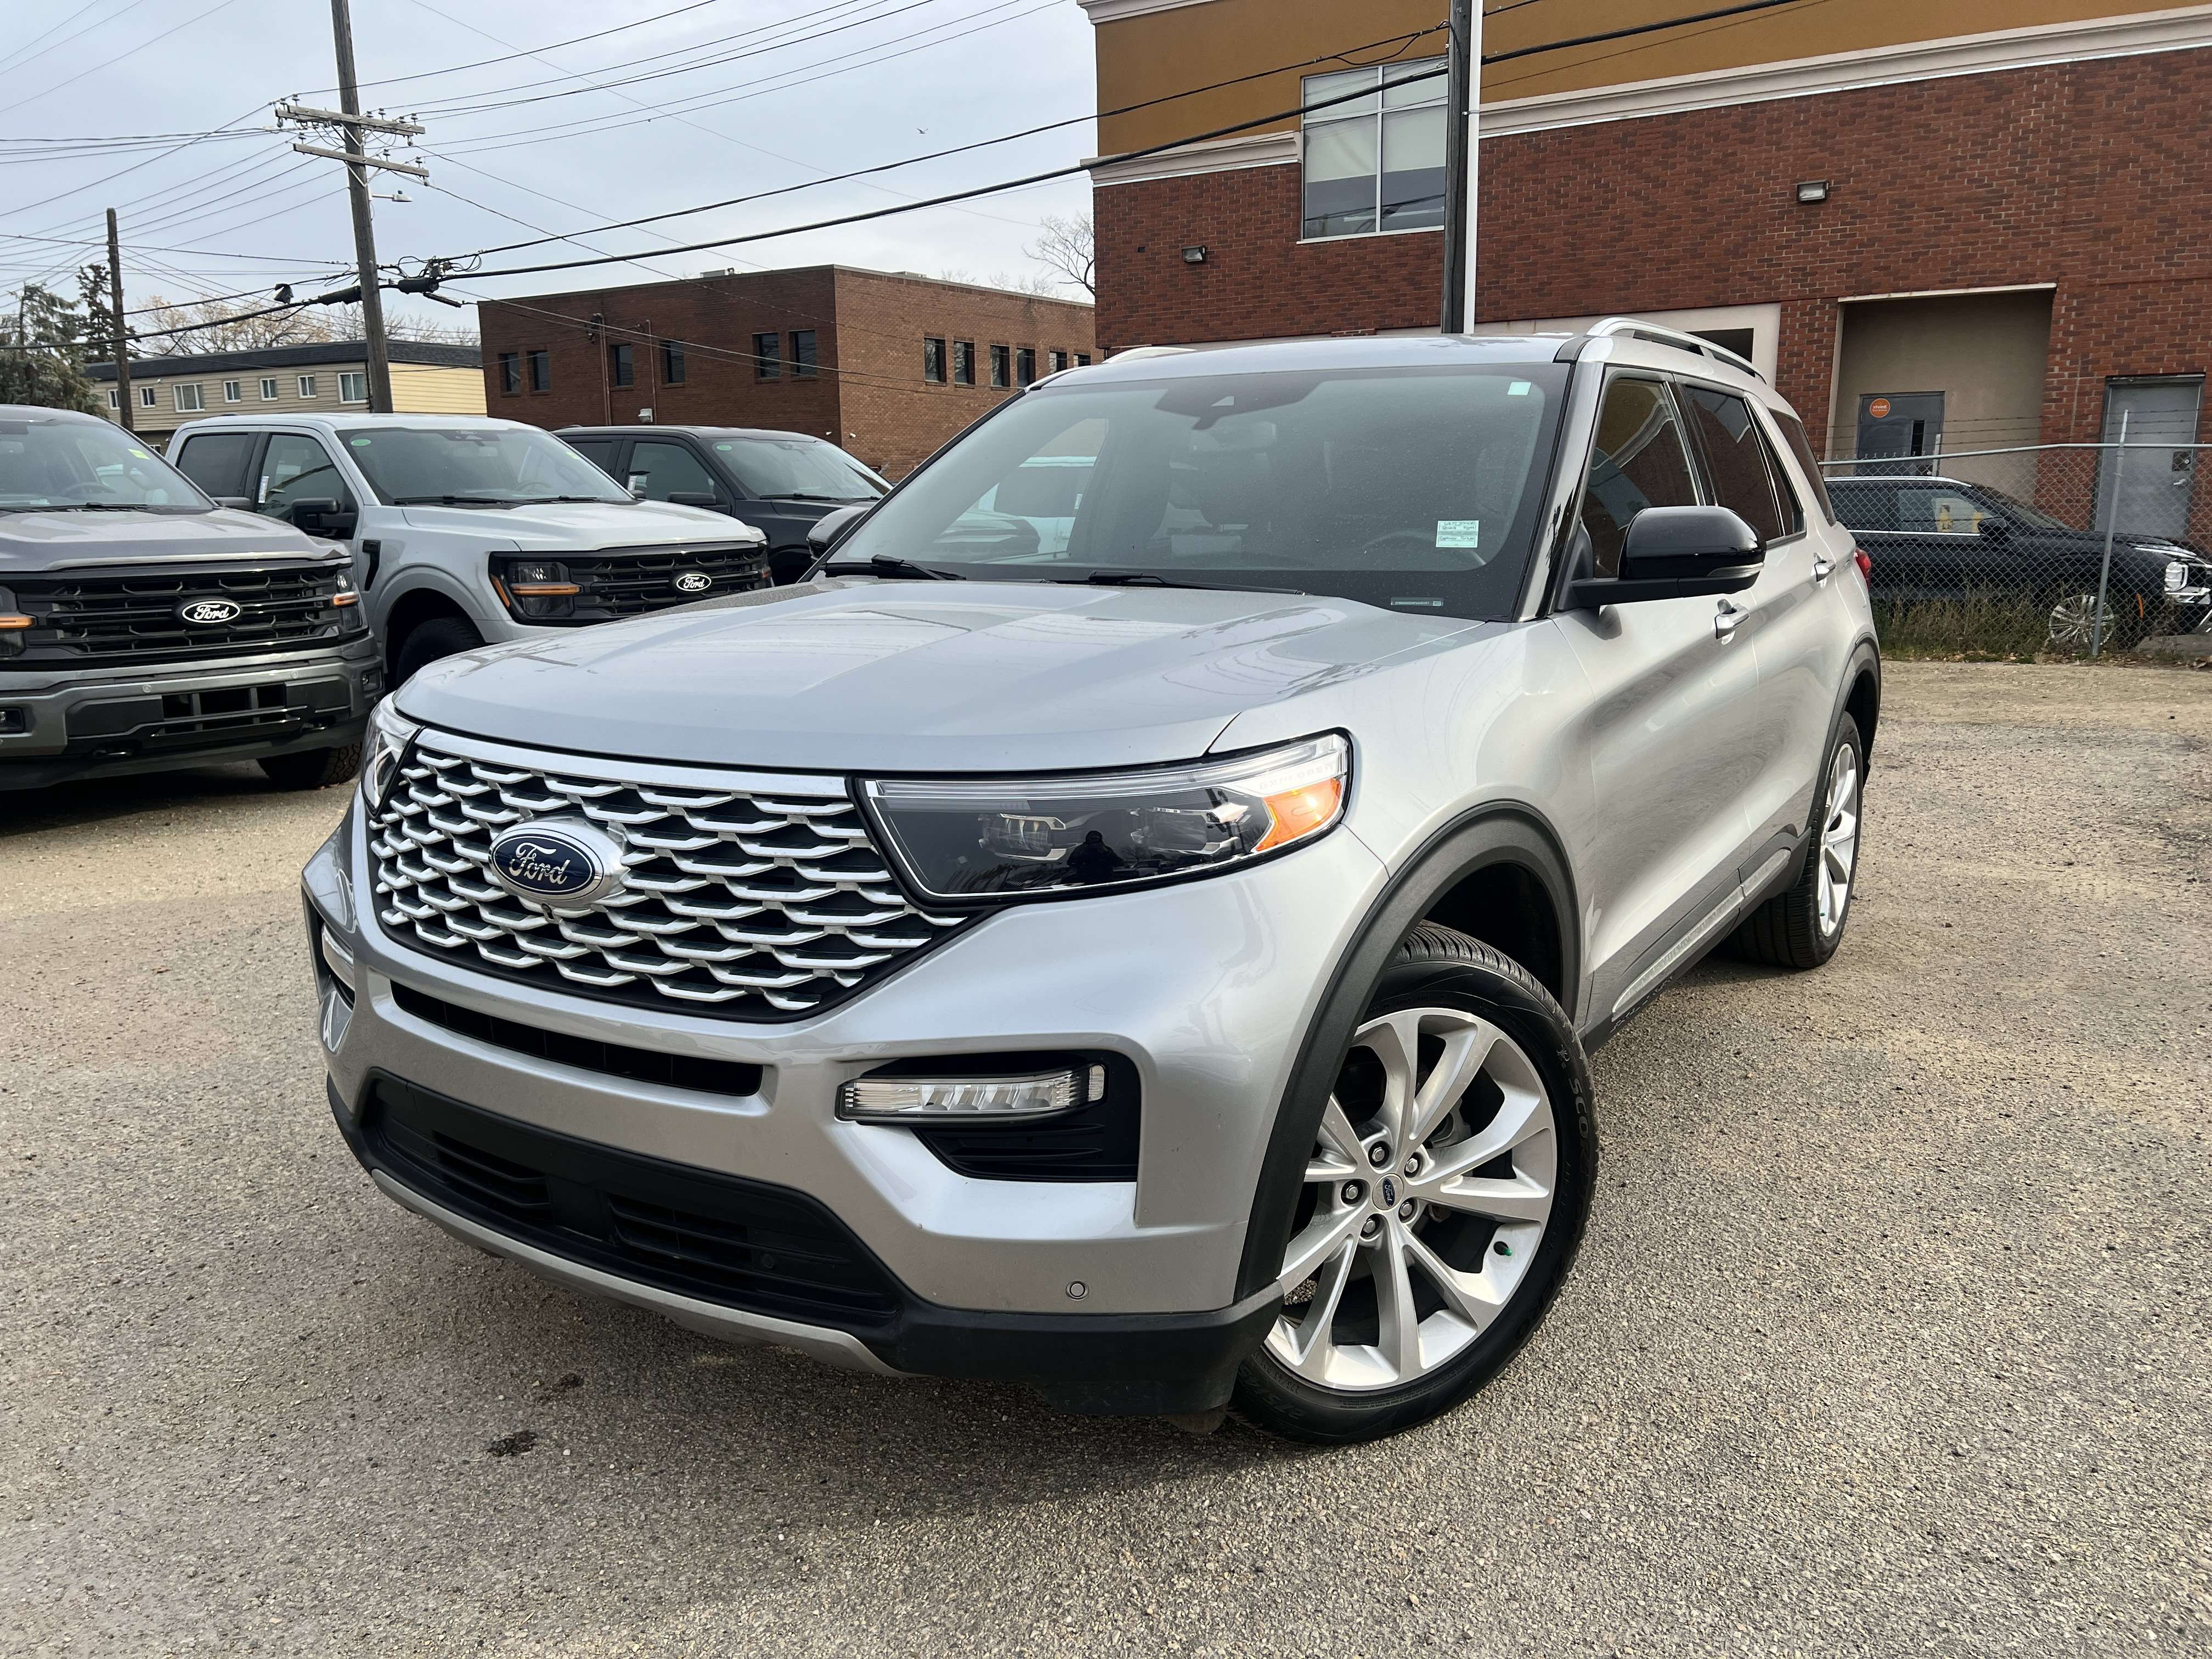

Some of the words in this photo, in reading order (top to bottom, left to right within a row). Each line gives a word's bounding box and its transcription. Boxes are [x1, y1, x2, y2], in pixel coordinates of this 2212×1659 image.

[683, 577, 705, 589] Ford
[194, 604, 229, 620] Ford
[509, 842, 571, 885] Ford
